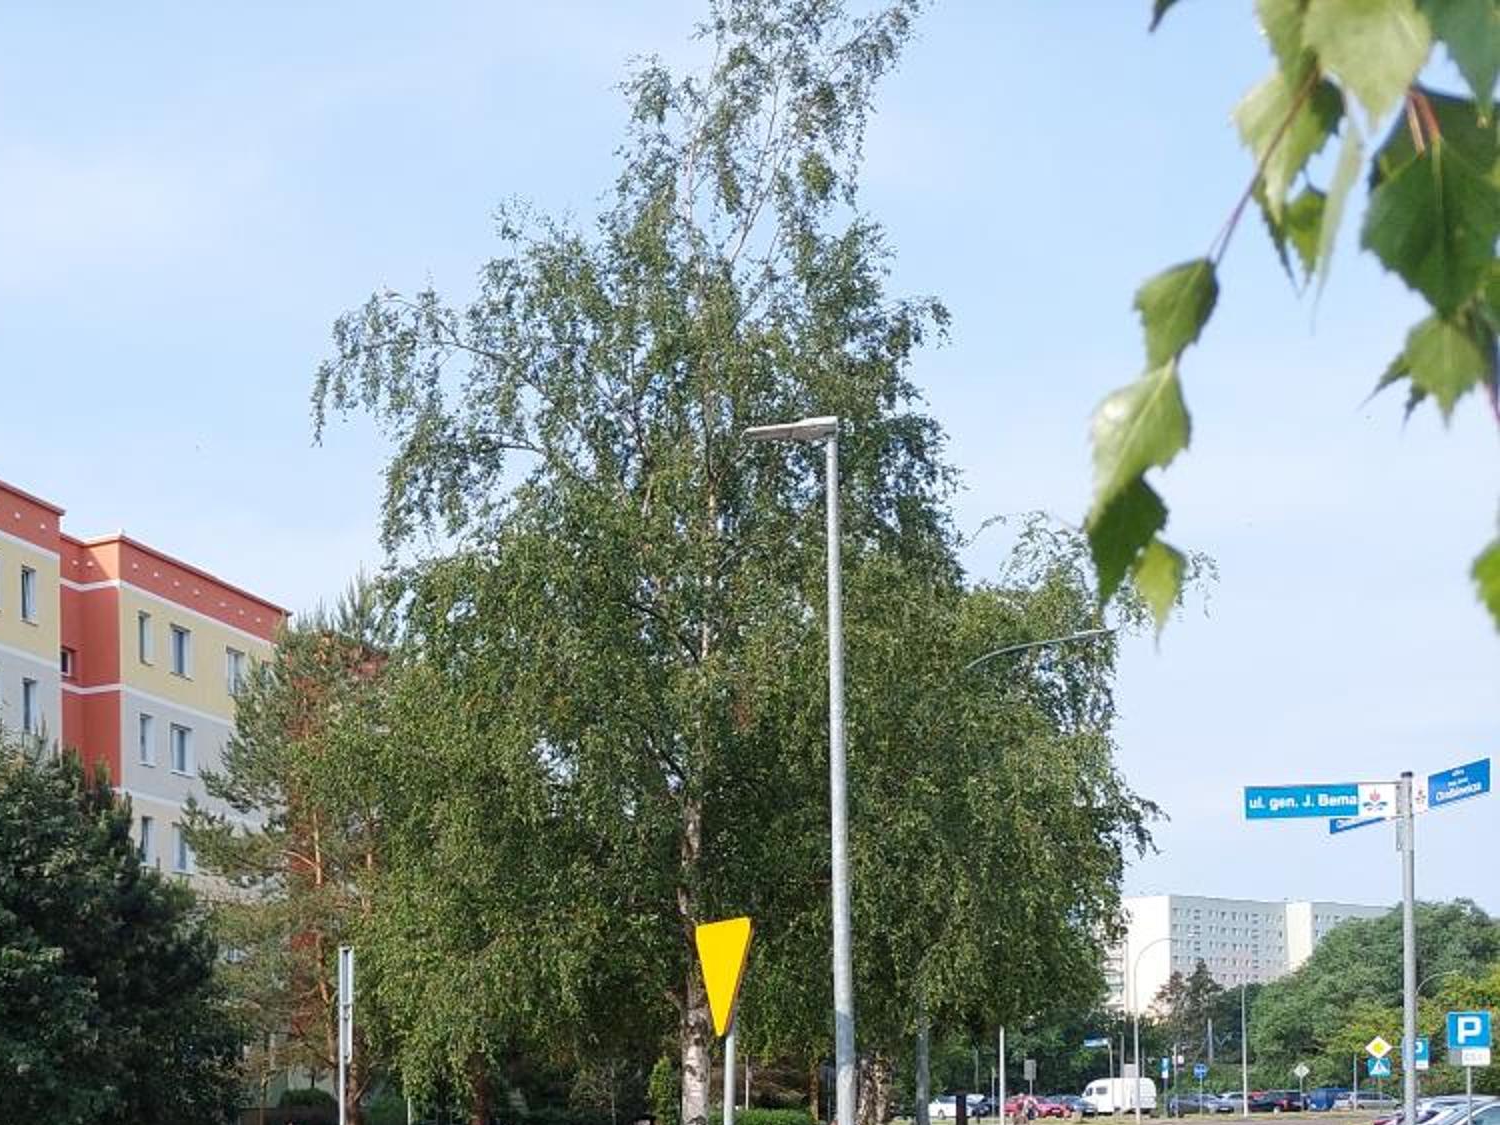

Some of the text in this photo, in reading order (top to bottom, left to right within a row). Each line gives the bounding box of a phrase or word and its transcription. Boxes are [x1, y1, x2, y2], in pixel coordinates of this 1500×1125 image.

[1249, 796, 1265, 809] ul.
[1302, 793, 1315, 807] J.
[1457, 1016, 1482, 1045] P
